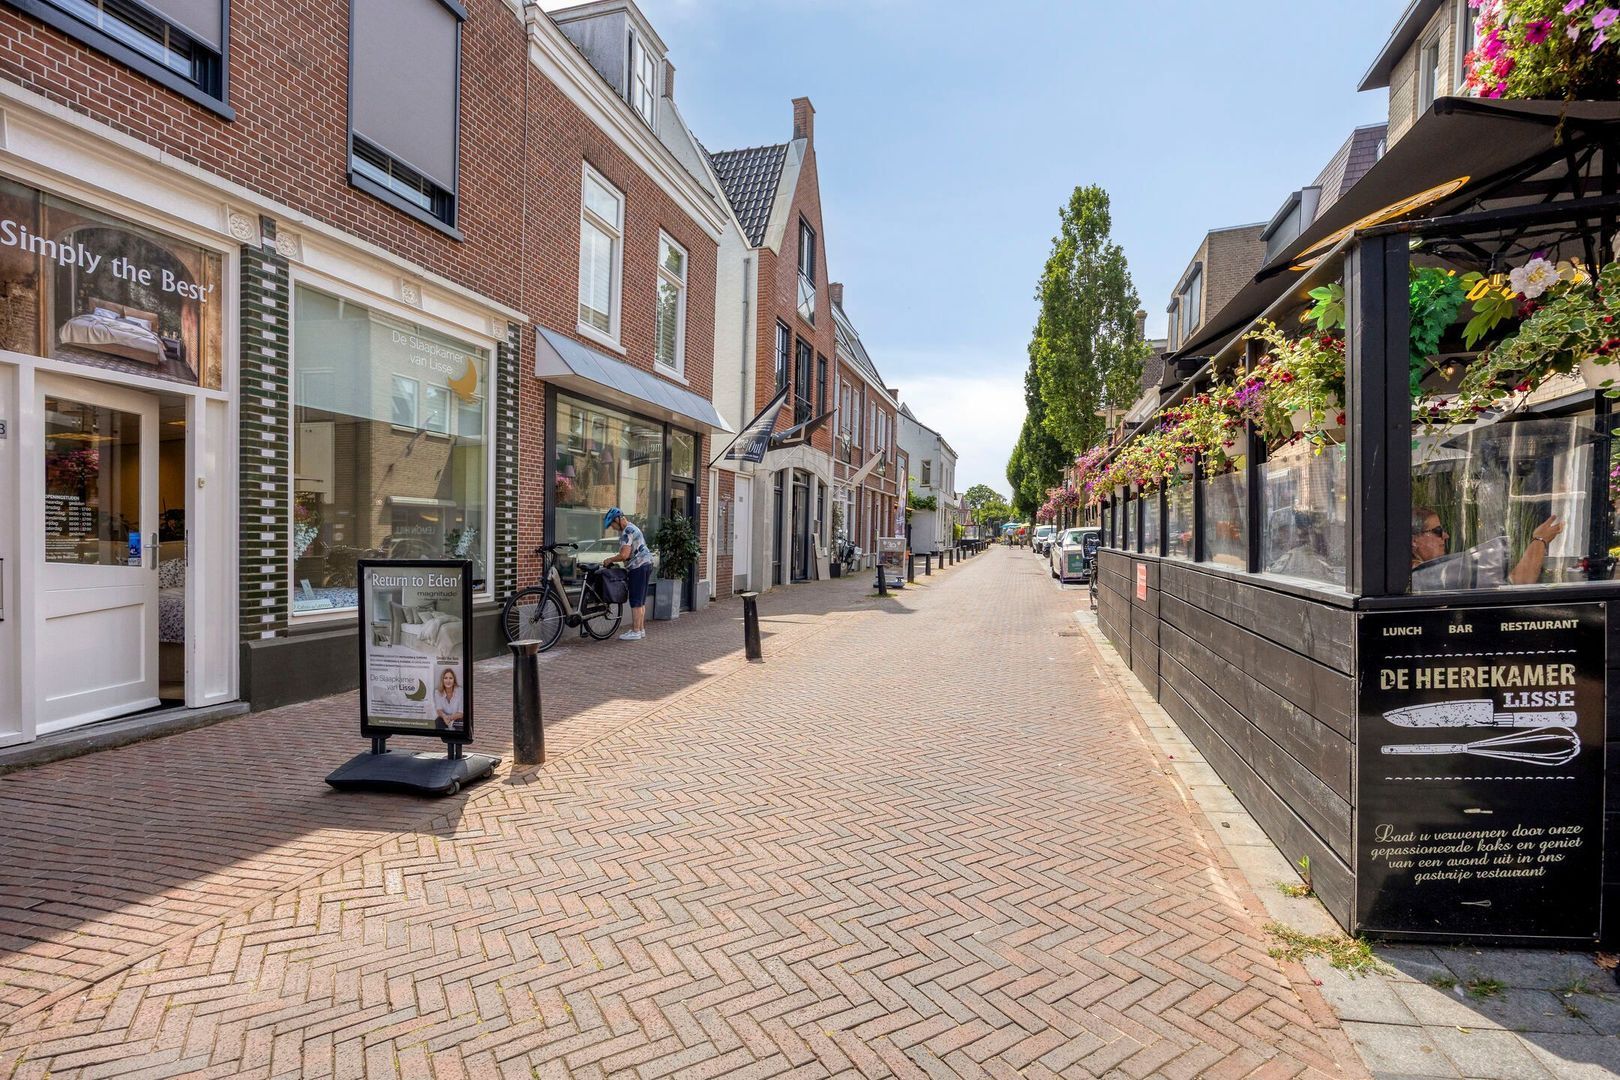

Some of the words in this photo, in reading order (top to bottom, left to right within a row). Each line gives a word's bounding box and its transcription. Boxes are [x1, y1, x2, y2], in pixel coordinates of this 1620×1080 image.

[1, 219, 102, 274] Simply
[111, 257, 151, 286] the
[392, 330, 407, 346] De
[409, 336, 464, 364] Slaapkamer
[410, 352, 428, 368] van
[429, 357, 454, 375] Lisse
[412, 575, 424, 587] to
[417, 590, 458, 598] magnitude
[1383, 626, 1422, 636] LUNCH
[1448, 624, 1473, 634] BAR
[1500, 619, 1579, 631] RESTAURANT
[1380, 668, 1409, 690] DE
[1415, 663, 1576, 689] HEEREKAMER
[398, 683, 416, 692] Lisse
[1503, 690, 1575, 708] LISSE
[1374, 823, 1417, 843] Laat
[1419, 833, 1431, 841] u
[1434, 829, 1509, 841] verwennen
[1511, 823, 1545, 837] door
[1548, 824, 1584, 835] onze
[1370, 841, 1474, 860] gepassioneerde
[1477, 838, 1514, 852] koks
[1516, 841, 1536, 850] en
[1539, 837, 1584, 852] geniet
[1388, 860, 1415, 869] van
[1418, 859, 1443, 868] een
[1446, 853, 1490, 866] avond
[1493, 853, 1514, 865] uit
[1517, 853, 1534, 864] in
[1537, 853, 1566, 863] ons
[1476, 866, 1547, 879] restaurant
